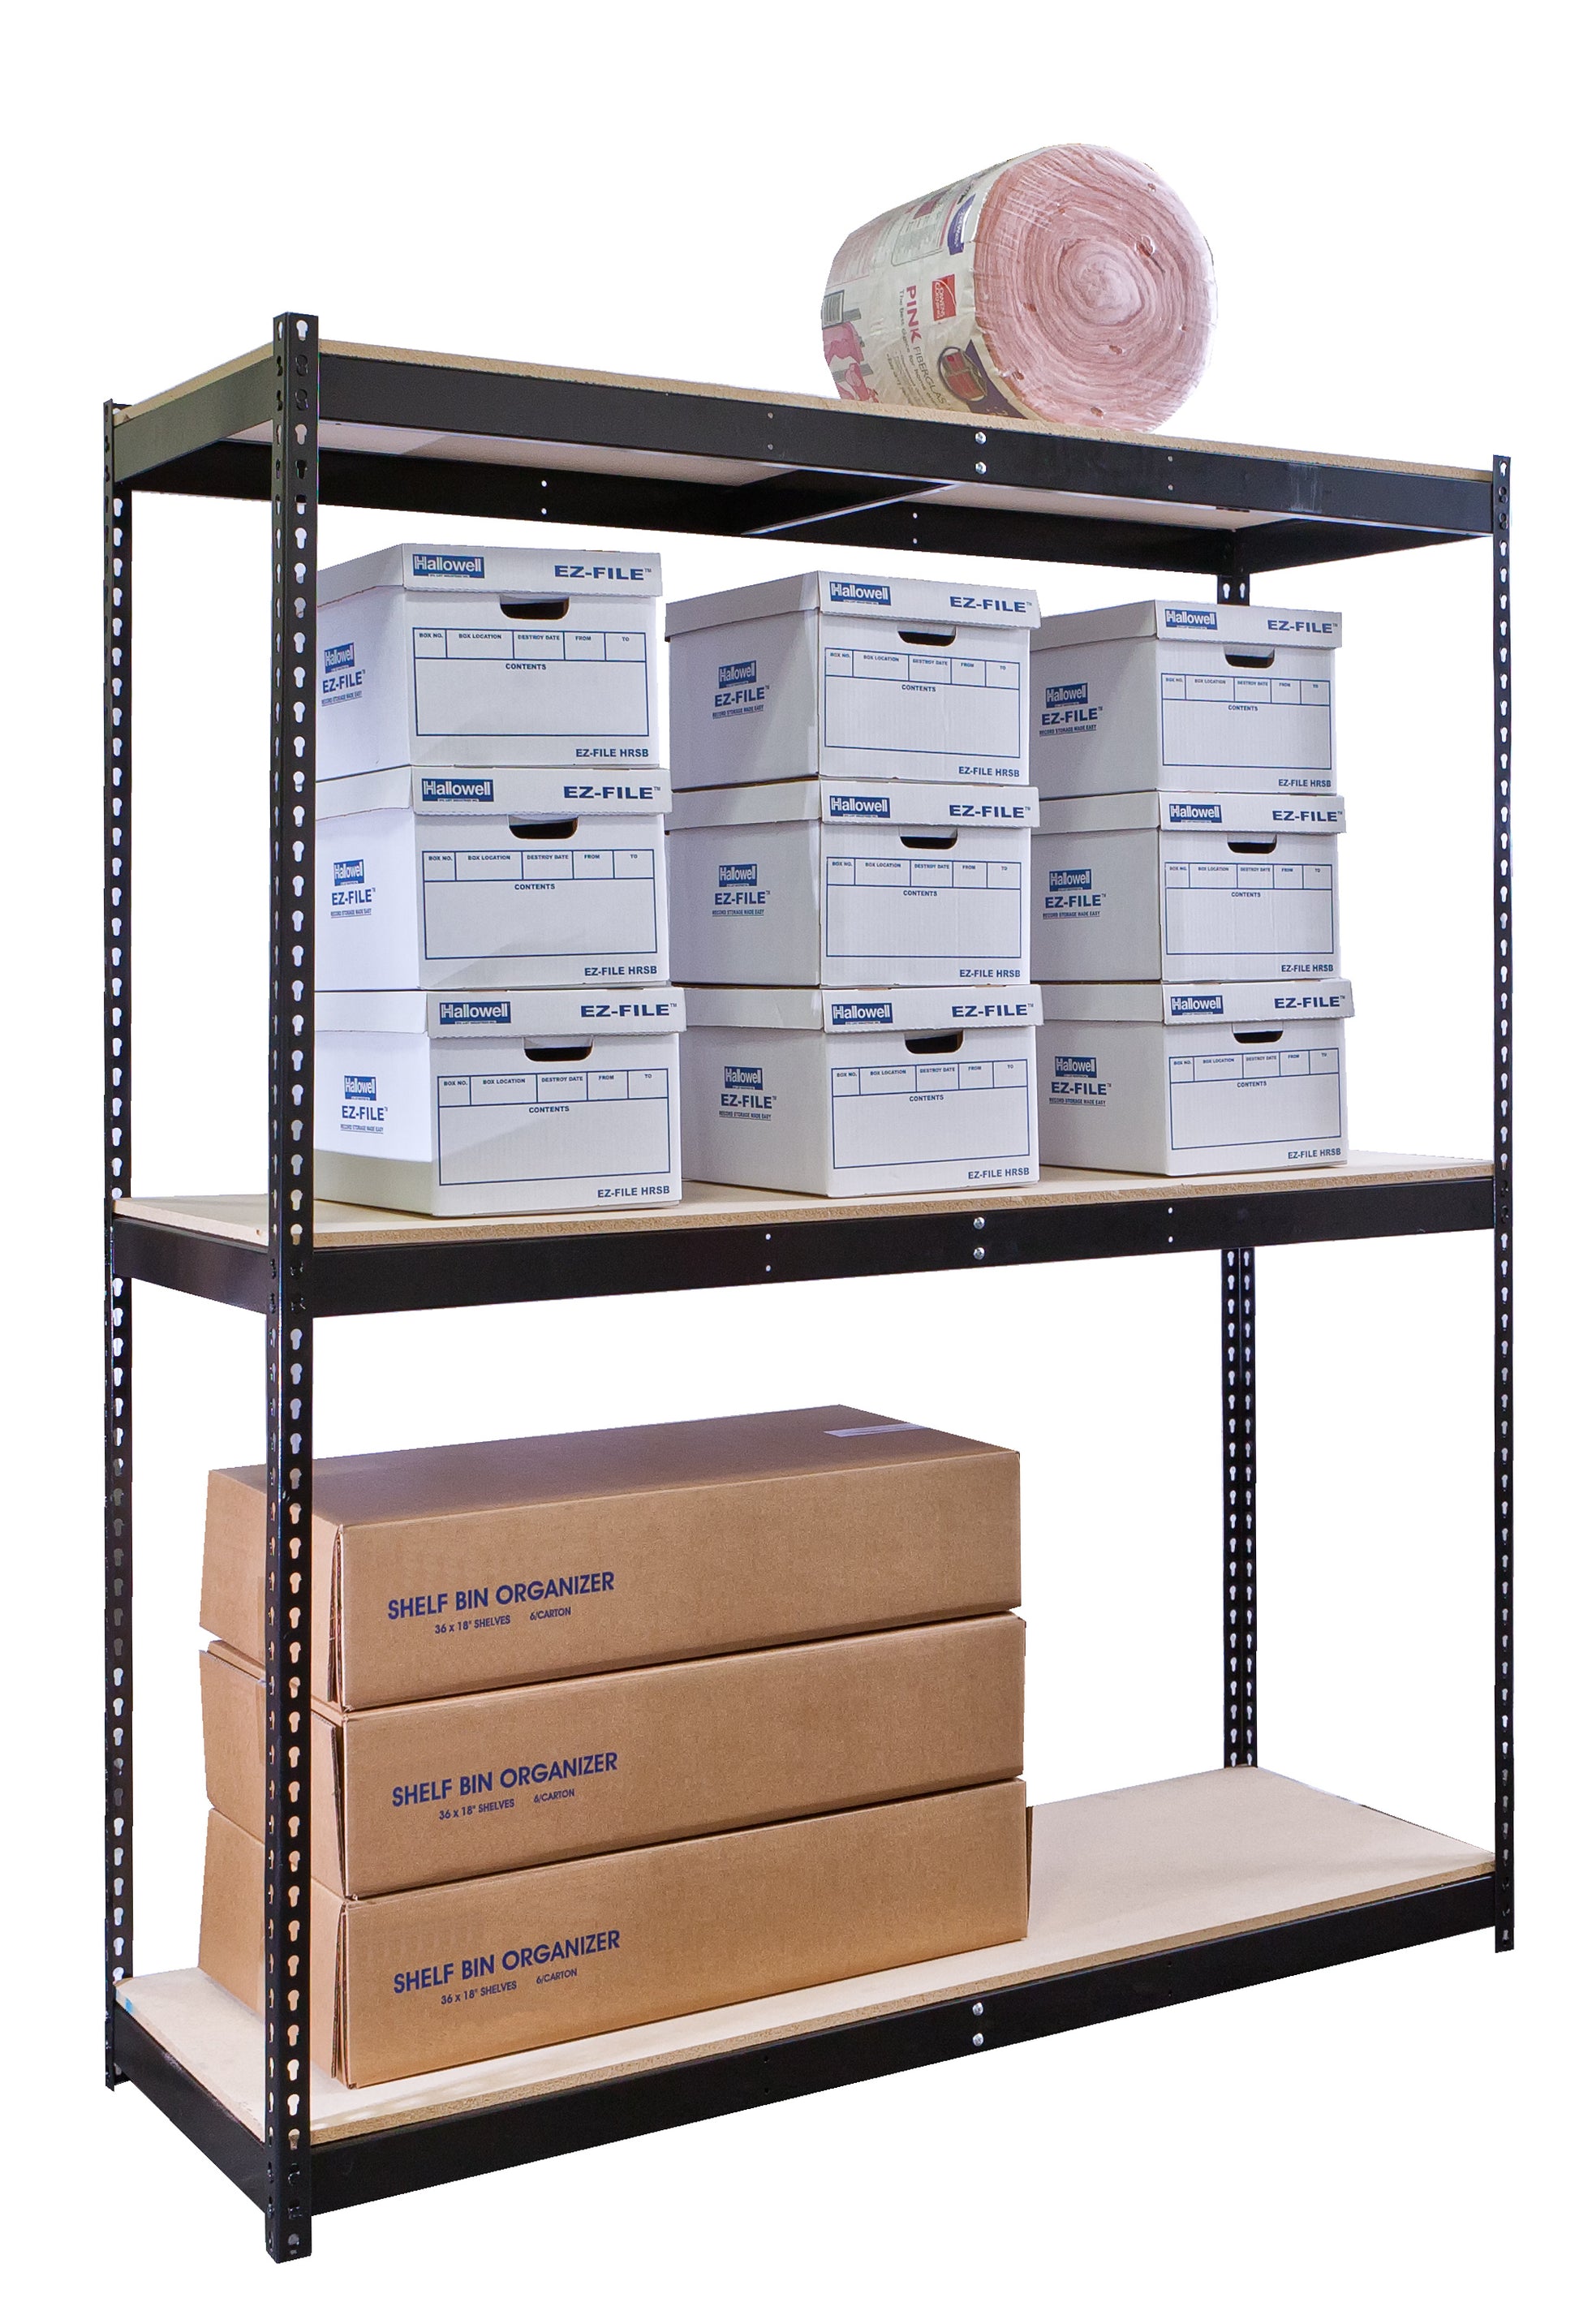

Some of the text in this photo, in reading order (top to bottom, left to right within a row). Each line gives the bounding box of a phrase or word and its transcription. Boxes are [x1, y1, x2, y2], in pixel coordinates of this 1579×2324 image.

[906, 285, 922, 343] PINK
[414, 555, 482, 573] Hallowell
[831, 583, 888, 601] Hallowell
[1166, 610, 1215, 626] Hallowell
[325, 644, 354, 666] Hallowell
[719, 665, 755, 683] Hallowell
[901, 684, 936, 692] CONTENTS
[1047, 686, 1086, 703] Hallowell
[576, 749, 648, 758] EZ-FILE HRSB
[959, 767, 1020, 777] EZ-FILE HRSB
[423, 781, 492, 797] Hallowell
[1279, 779, 1308, 787] EZ-FILE
[830, 798, 888, 813] Hallowell
[1170, 805, 1220, 819] Hallowell
[334, 861, 364, 881] Hallowell
[720, 866, 756, 884] Hallowell
[1050, 872, 1091, 887] Hallowell
[584, 966, 657, 976] EZ-FILE HRSB
[960, 969, 1021, 978] EZ-FILE HRSB
[441, 1004, 509, 1020] Hallowell
[1172, 997, 1221, 1011] Hallowell
[833, 1005, 889, 1021] Hallowell
[1056, 1059, 1095, 1074] Hallowell
[725, 1069, 762, 1086] Hallowell
[345, 1078, 375, 1096] Hallowell
[529, 1105, 570, 1113] CONTENTS
[1288, 1148, 1340, 1160] EZ-FILE HRSB
[968, 1168, 1030, 1180] EZ-FILE HRSB
[597, 1186, 670, 1198] EZ-FILE HRSB
[388, 1572, 615, 1620] SHELF BIN ORGANIZER
[530, 1607, 571, 1621] 6/CARTON
[435, 1625, 446, 1634] 36
[449, 1625, 454, 1633] x
[474, 1616, 510, 1629] SHELVES
[393, 1753, 617, 1806] SHELF BIN ORGANIZER
[534, 1788, 574, 1803] 6/CARTON
[439, 1810, 451, 1820] 36
[478, 1799, 514, 1813] SHELVES
[394, 1930, 620, 1994] SHELF BIN ORGANIZER
[536, 1969, 577, 1985] 6/CARTON
[441, 1995, 453, 2004] 36
[480, 1981, 517, 1996] SHELVES
